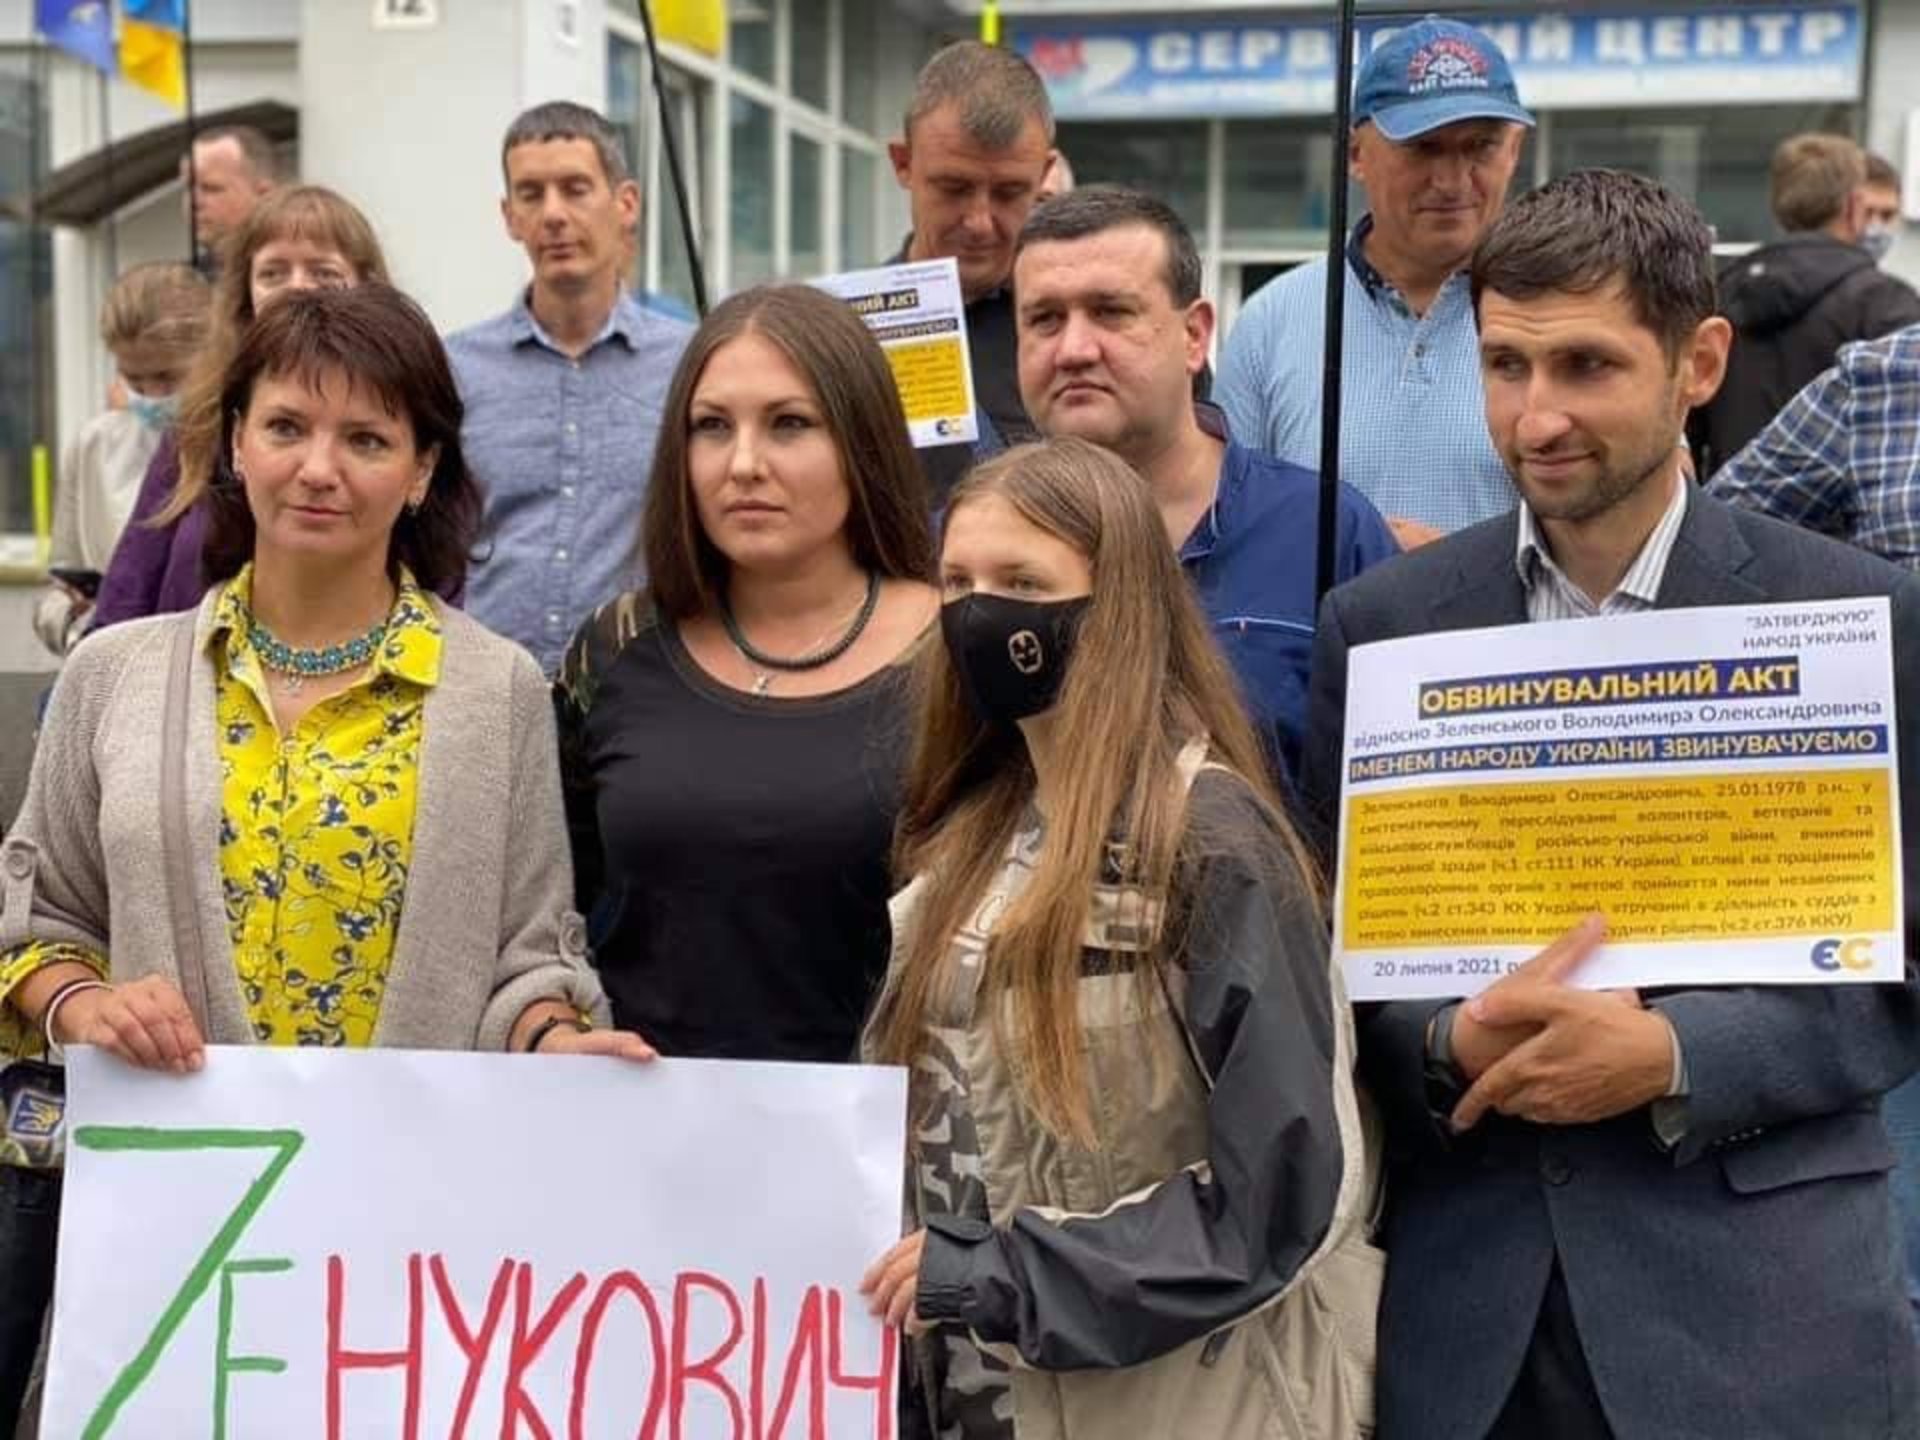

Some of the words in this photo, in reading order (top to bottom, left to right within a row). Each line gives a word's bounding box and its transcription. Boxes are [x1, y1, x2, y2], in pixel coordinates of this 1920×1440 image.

[1598, 12, 1845, 65] ЦЕНТР
[1746, 608, 1875, 629] "ЗАТВЕРДЖУЮ"
[1743, 634, 1802, 650] НАРОД
[1804, 629, 1876, 645] УКРАЇНИ
[1421, 664, 1717, 713] ОБВИНУВАЛЬНИЙ
[1728, 664, 1797, 692] АКТ
[1353, 725, 1430, 749] відносно
[1435, 718, 1556, 739] Зеленського
[1562, 707, 1693, 730] Володимира
[1700, 701, 1882, 722] Олександровича
[1352, 754, 1434, 778] ІМЕНЕМ
[1441, 747, 1538, 770] НАРОДУ
[1548, 737, 1654, 763] УКРАЇНИ
[1662, 730, 1876, 759] ЗВИНУВАЧУЄМО
[1581, 856, 1606, 869] КК
[1503, 900, 1528, 913] КК
[1373, 960, 1396, 977] 20
[1400, 961, 1452, 976] липня
[1457, 958, 1501, 975] 2021
